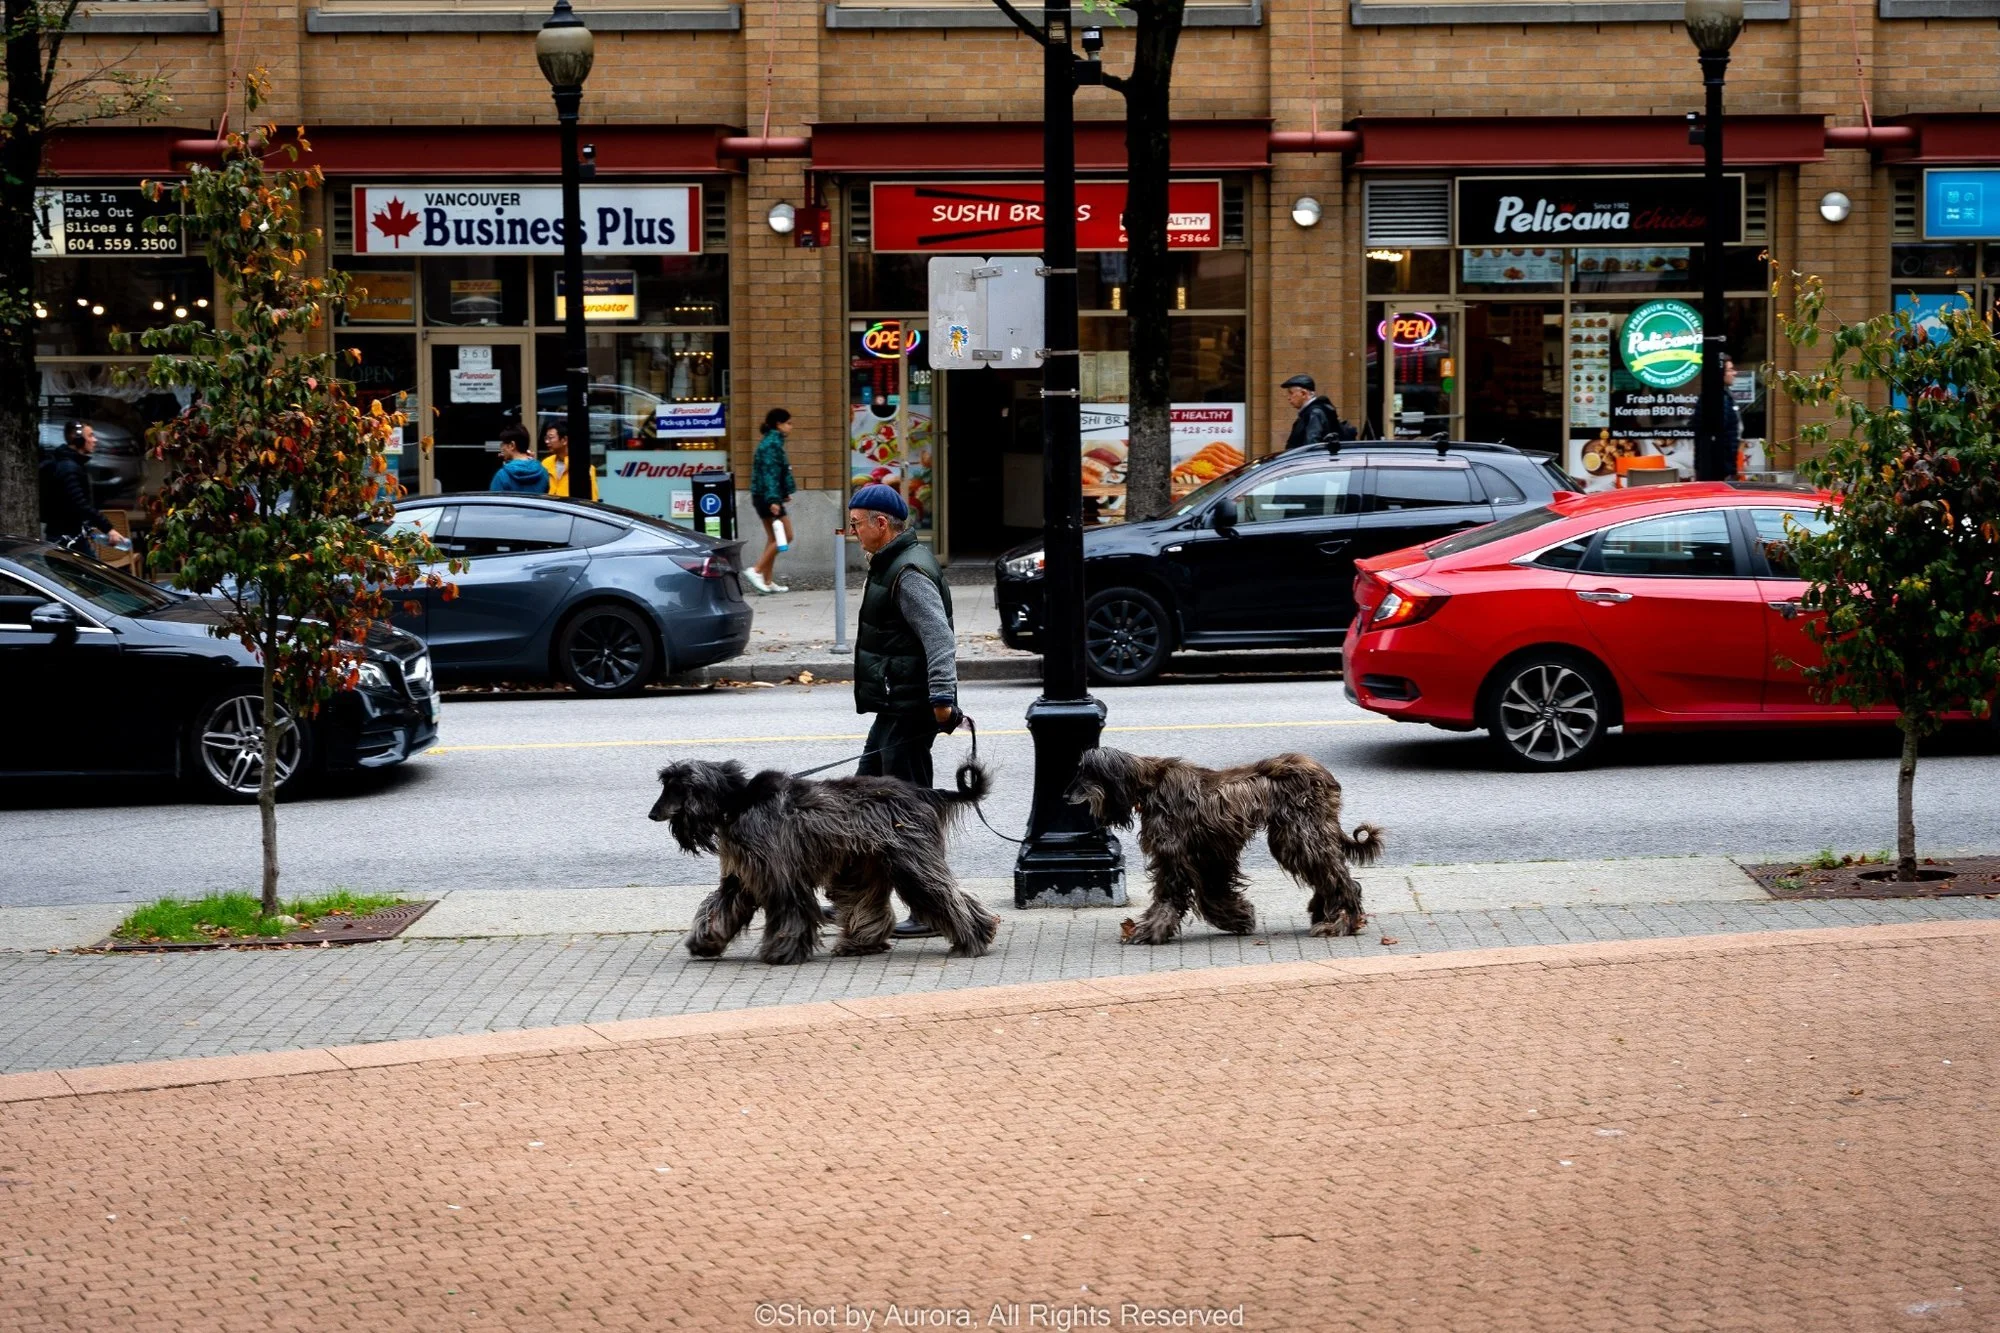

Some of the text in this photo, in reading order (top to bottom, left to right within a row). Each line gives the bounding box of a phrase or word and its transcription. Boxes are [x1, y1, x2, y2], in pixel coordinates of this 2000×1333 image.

[66, 193, 117, 203] Eat In
[425, 193, 521, 206] VANCOUVER
[66, 208, 133, 218] Take Out
[932, 204, 1000, 222] SUSHI
[66, 222, 116, 233] Slices
[126, 222, 134, 233] &
[597, 207, 675, 246] Plus
[68, 238, 177, 250] 604.559.3500
[583, 303, 629, 312] urolator
[1630, 303, 1700, 330] PREMIUM CHICKEN
[1626, 394, 1655, 404] Fresh
[1657, 394, 1664, 403] &
[1181, 411, 1230, 420] HEALTHY
[1615, 406, 1650, 416] Korean
[1652, 406, 1675, 416] BBQ
[660, 419, 685, 427] Pick-up
[693, 418, 722, 426] Drop-off
[1081, 416, 1100, 425] SHI
